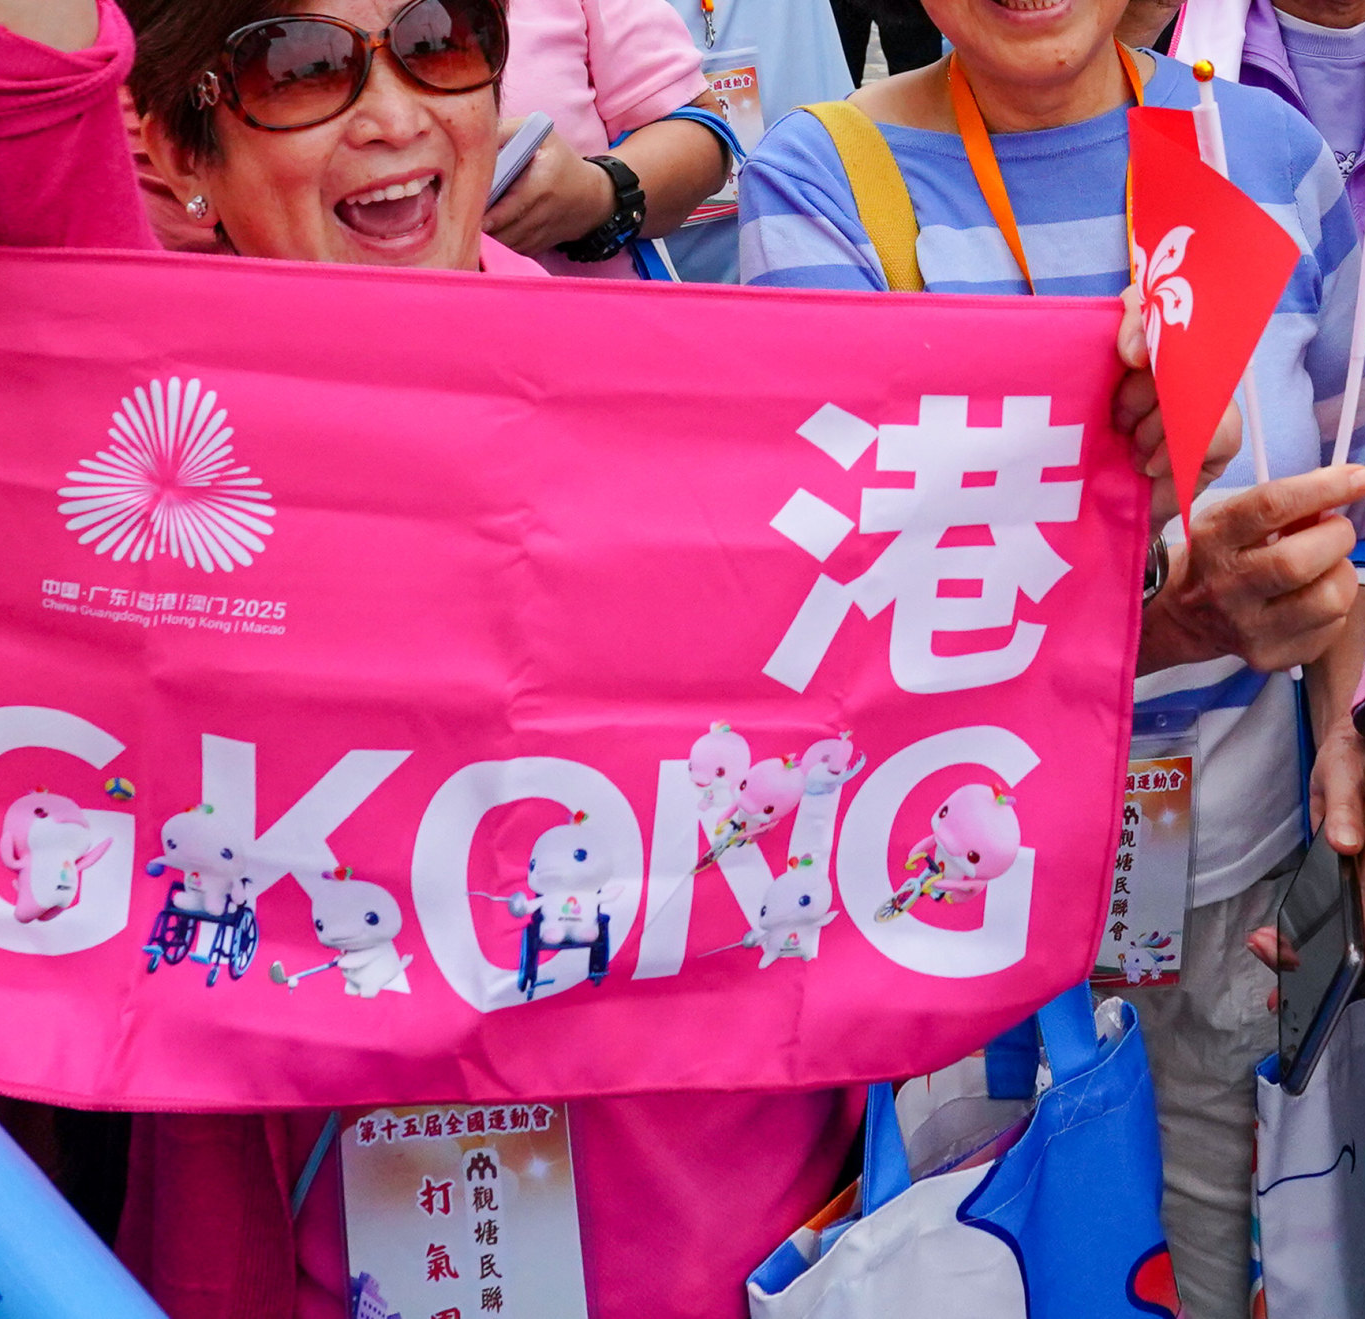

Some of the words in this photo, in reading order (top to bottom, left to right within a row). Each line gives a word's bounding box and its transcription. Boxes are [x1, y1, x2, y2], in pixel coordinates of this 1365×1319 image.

[763, 394, 1085, 694] 港
[42, 597, 77, 613] China
[80, 605, 151, 628] Guangdong
[161, 613, 196, 629] Hong
[198, 616, 232, 634] Kong
[242, 621, 286, 636] Macao
[230, 598, 287, 620] 2025
[185, 725, 1040, 1013] KONG
[1109, 829, 1137, 942] 觀塘民聯會
[358, 1105, 553, 1143] 第十五屆全國運動會
[472, 1185, 503, 1314] 觀塘民聯
